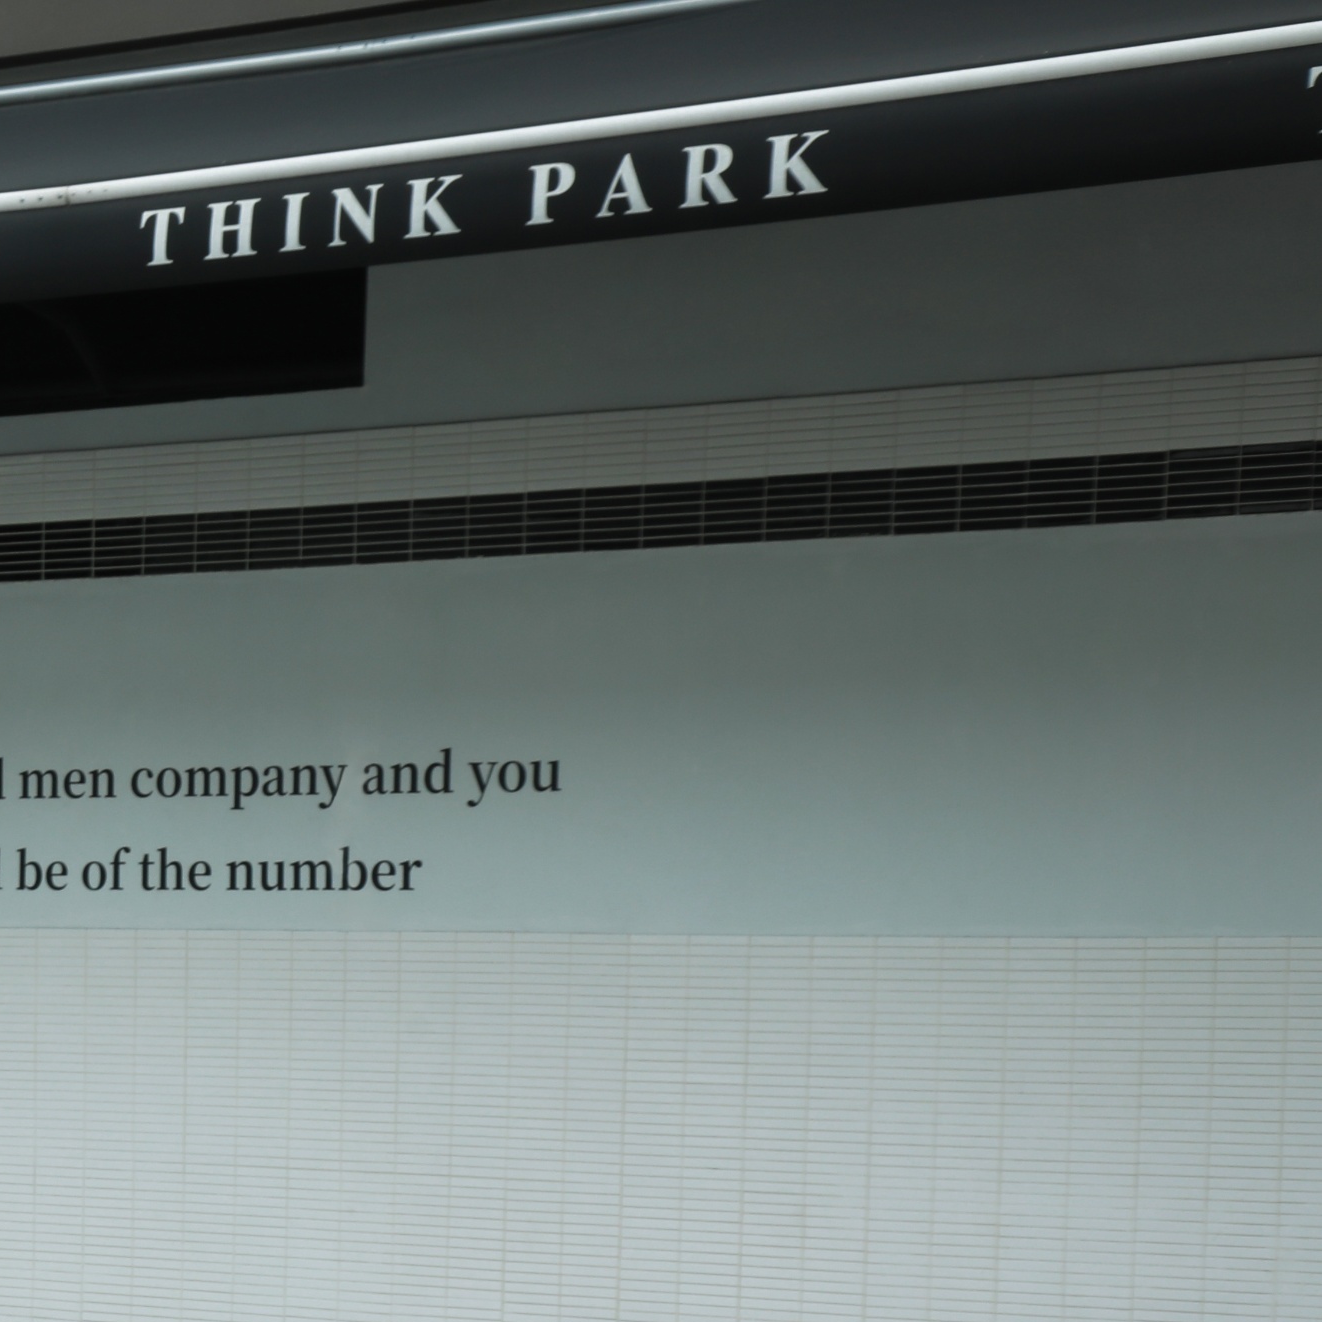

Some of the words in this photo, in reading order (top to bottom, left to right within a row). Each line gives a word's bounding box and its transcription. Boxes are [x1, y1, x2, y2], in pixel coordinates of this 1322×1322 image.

[140, 174, 463, 267] THINK
[525, 129, 830, 227] PARK
[19, 768, 117, 800] men
[130, 764, 348, 811] company
[361, 747, 455, 796] and
[466, 759, 563, 808] you
[16, 847, 69, 891] be
[81, 846, 131, 891] of
[138, 847, 213, 892] the
[226, 846, 424, 892] number
